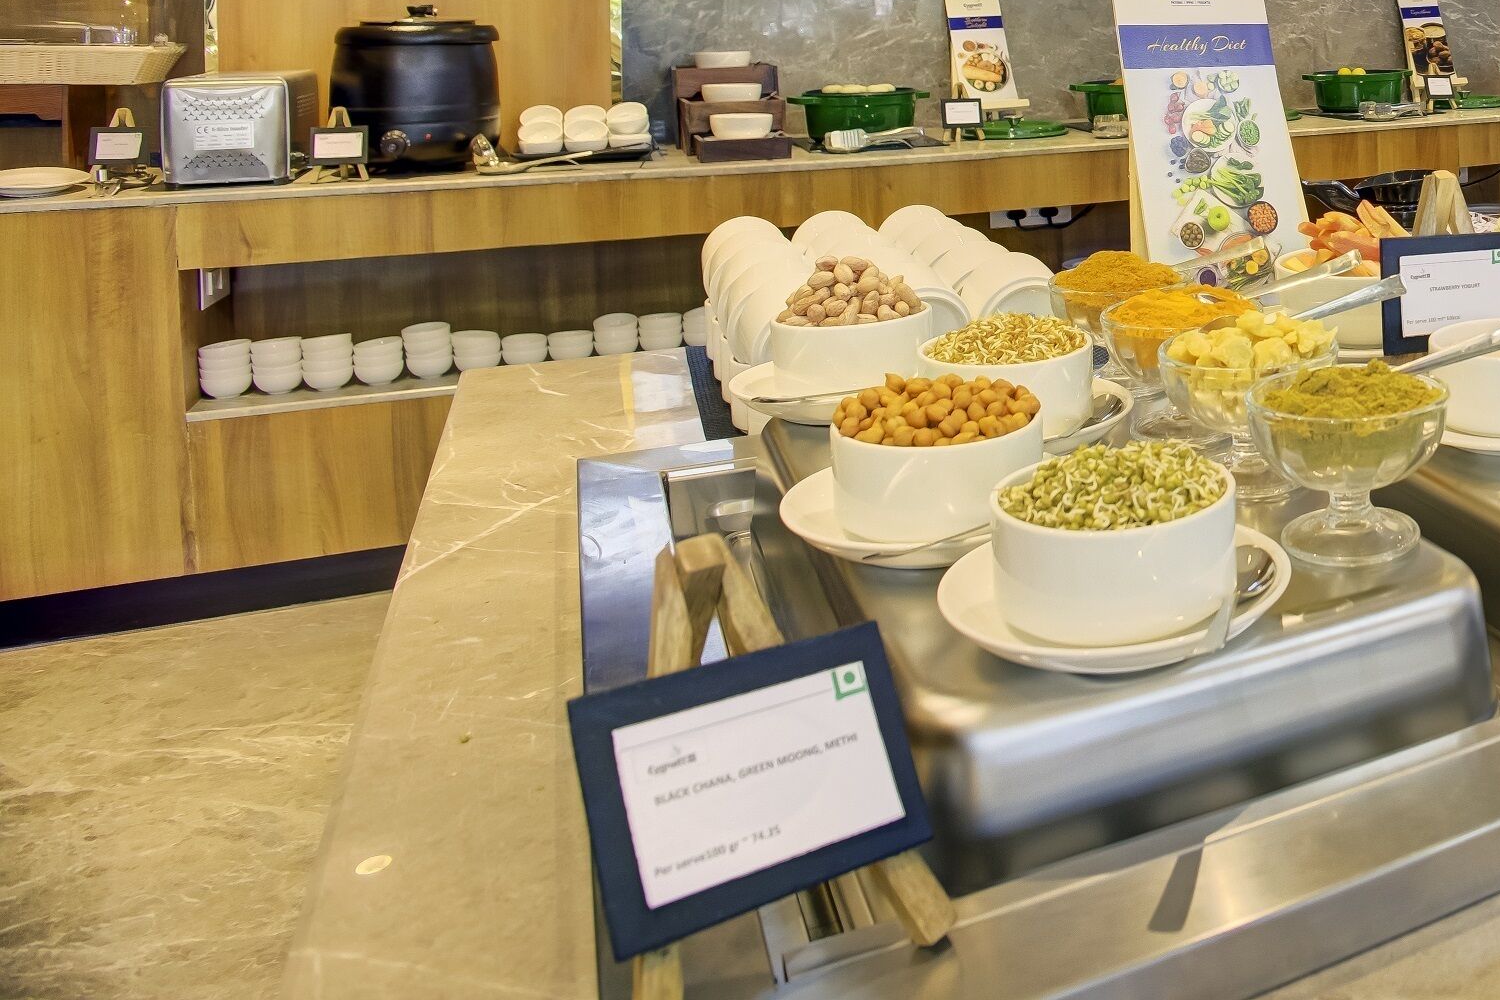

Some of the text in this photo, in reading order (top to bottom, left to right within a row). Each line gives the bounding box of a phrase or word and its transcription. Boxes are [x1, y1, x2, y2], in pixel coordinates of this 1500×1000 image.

[1147, 34, 1247, 56] Healthy Diet
[654, 787, 690, 806] BLACK
[692, 773, 736, 795] CHANA,
[738, 760, 775, 779] GREEN
[824, 733, 858, 752] METHI
[654, 863, 673, 877] Per
